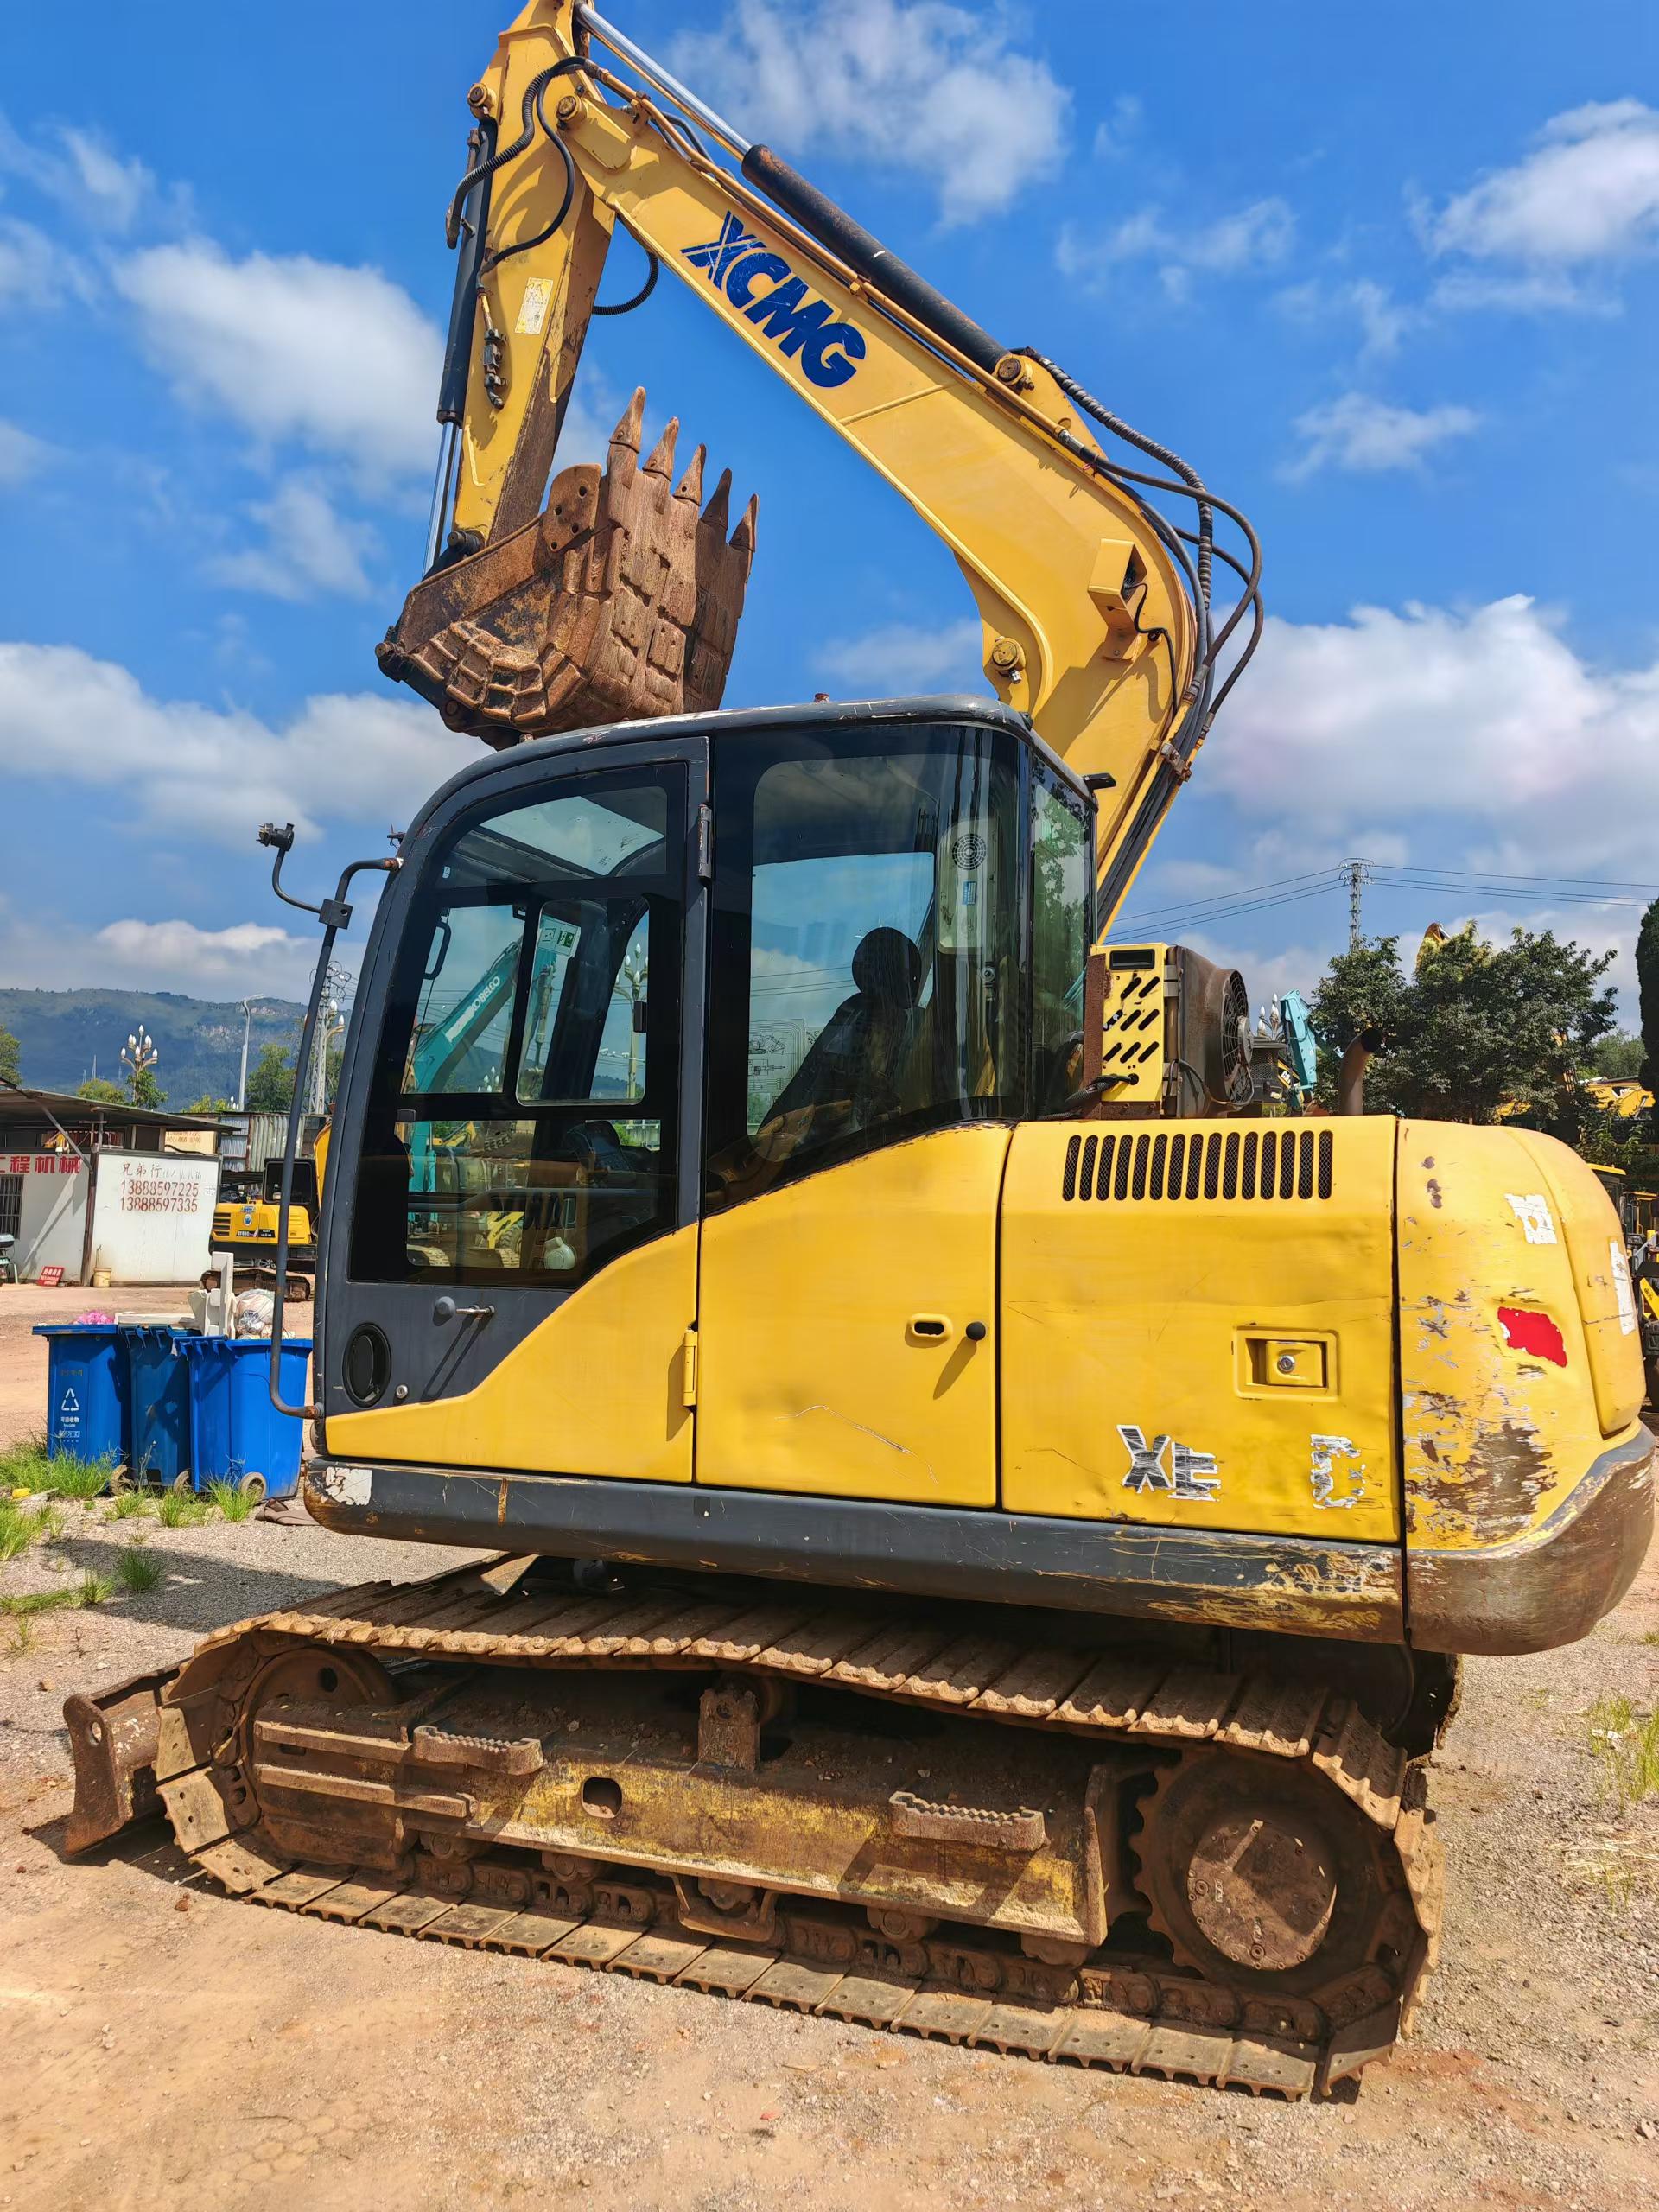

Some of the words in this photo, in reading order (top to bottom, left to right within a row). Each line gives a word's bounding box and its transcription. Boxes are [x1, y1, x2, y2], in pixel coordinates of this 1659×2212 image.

[681, 211, 867, 388] XCMG
[119, 1196, 198, 1212] 13888597335
[120, 1179, 199, 1198] 13888597225
[1116, 1424, 1221, 1502] XE
